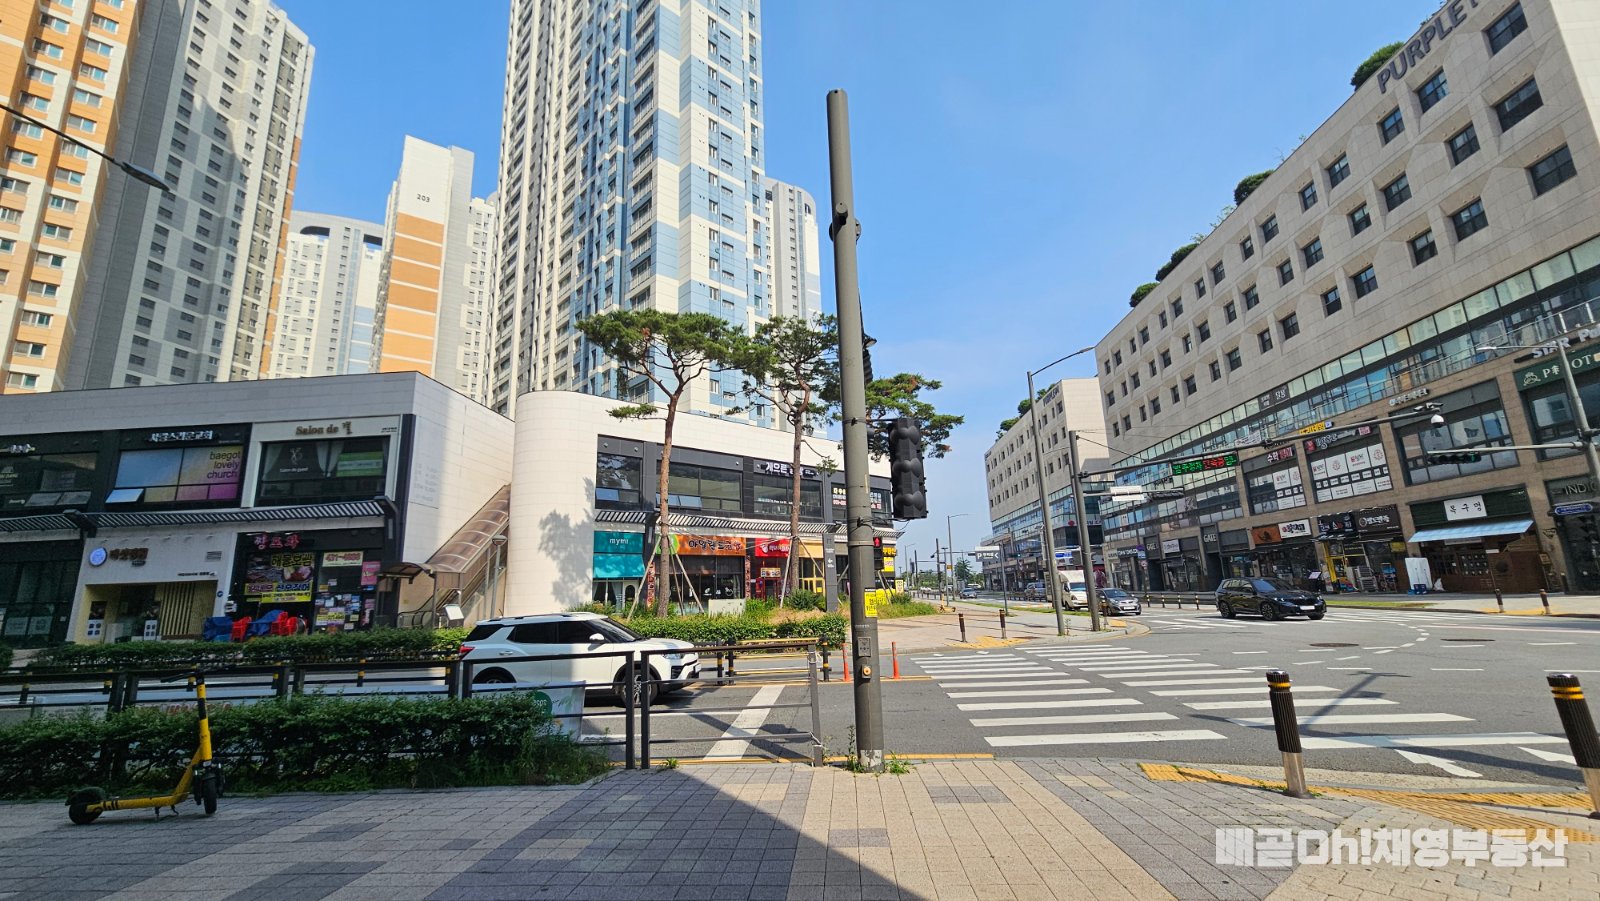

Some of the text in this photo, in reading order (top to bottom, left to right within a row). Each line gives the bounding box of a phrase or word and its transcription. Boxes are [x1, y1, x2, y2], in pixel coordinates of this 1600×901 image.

[1376, 0, 1478, 94] PURPLE
[417, 193, 430, 203] 203
[209, 451, 241, 461] baegot
[213, 461, 240, 470] lovely
[206, 470, 239, 480] church
[1203, 532, 1217, 542] GATE
